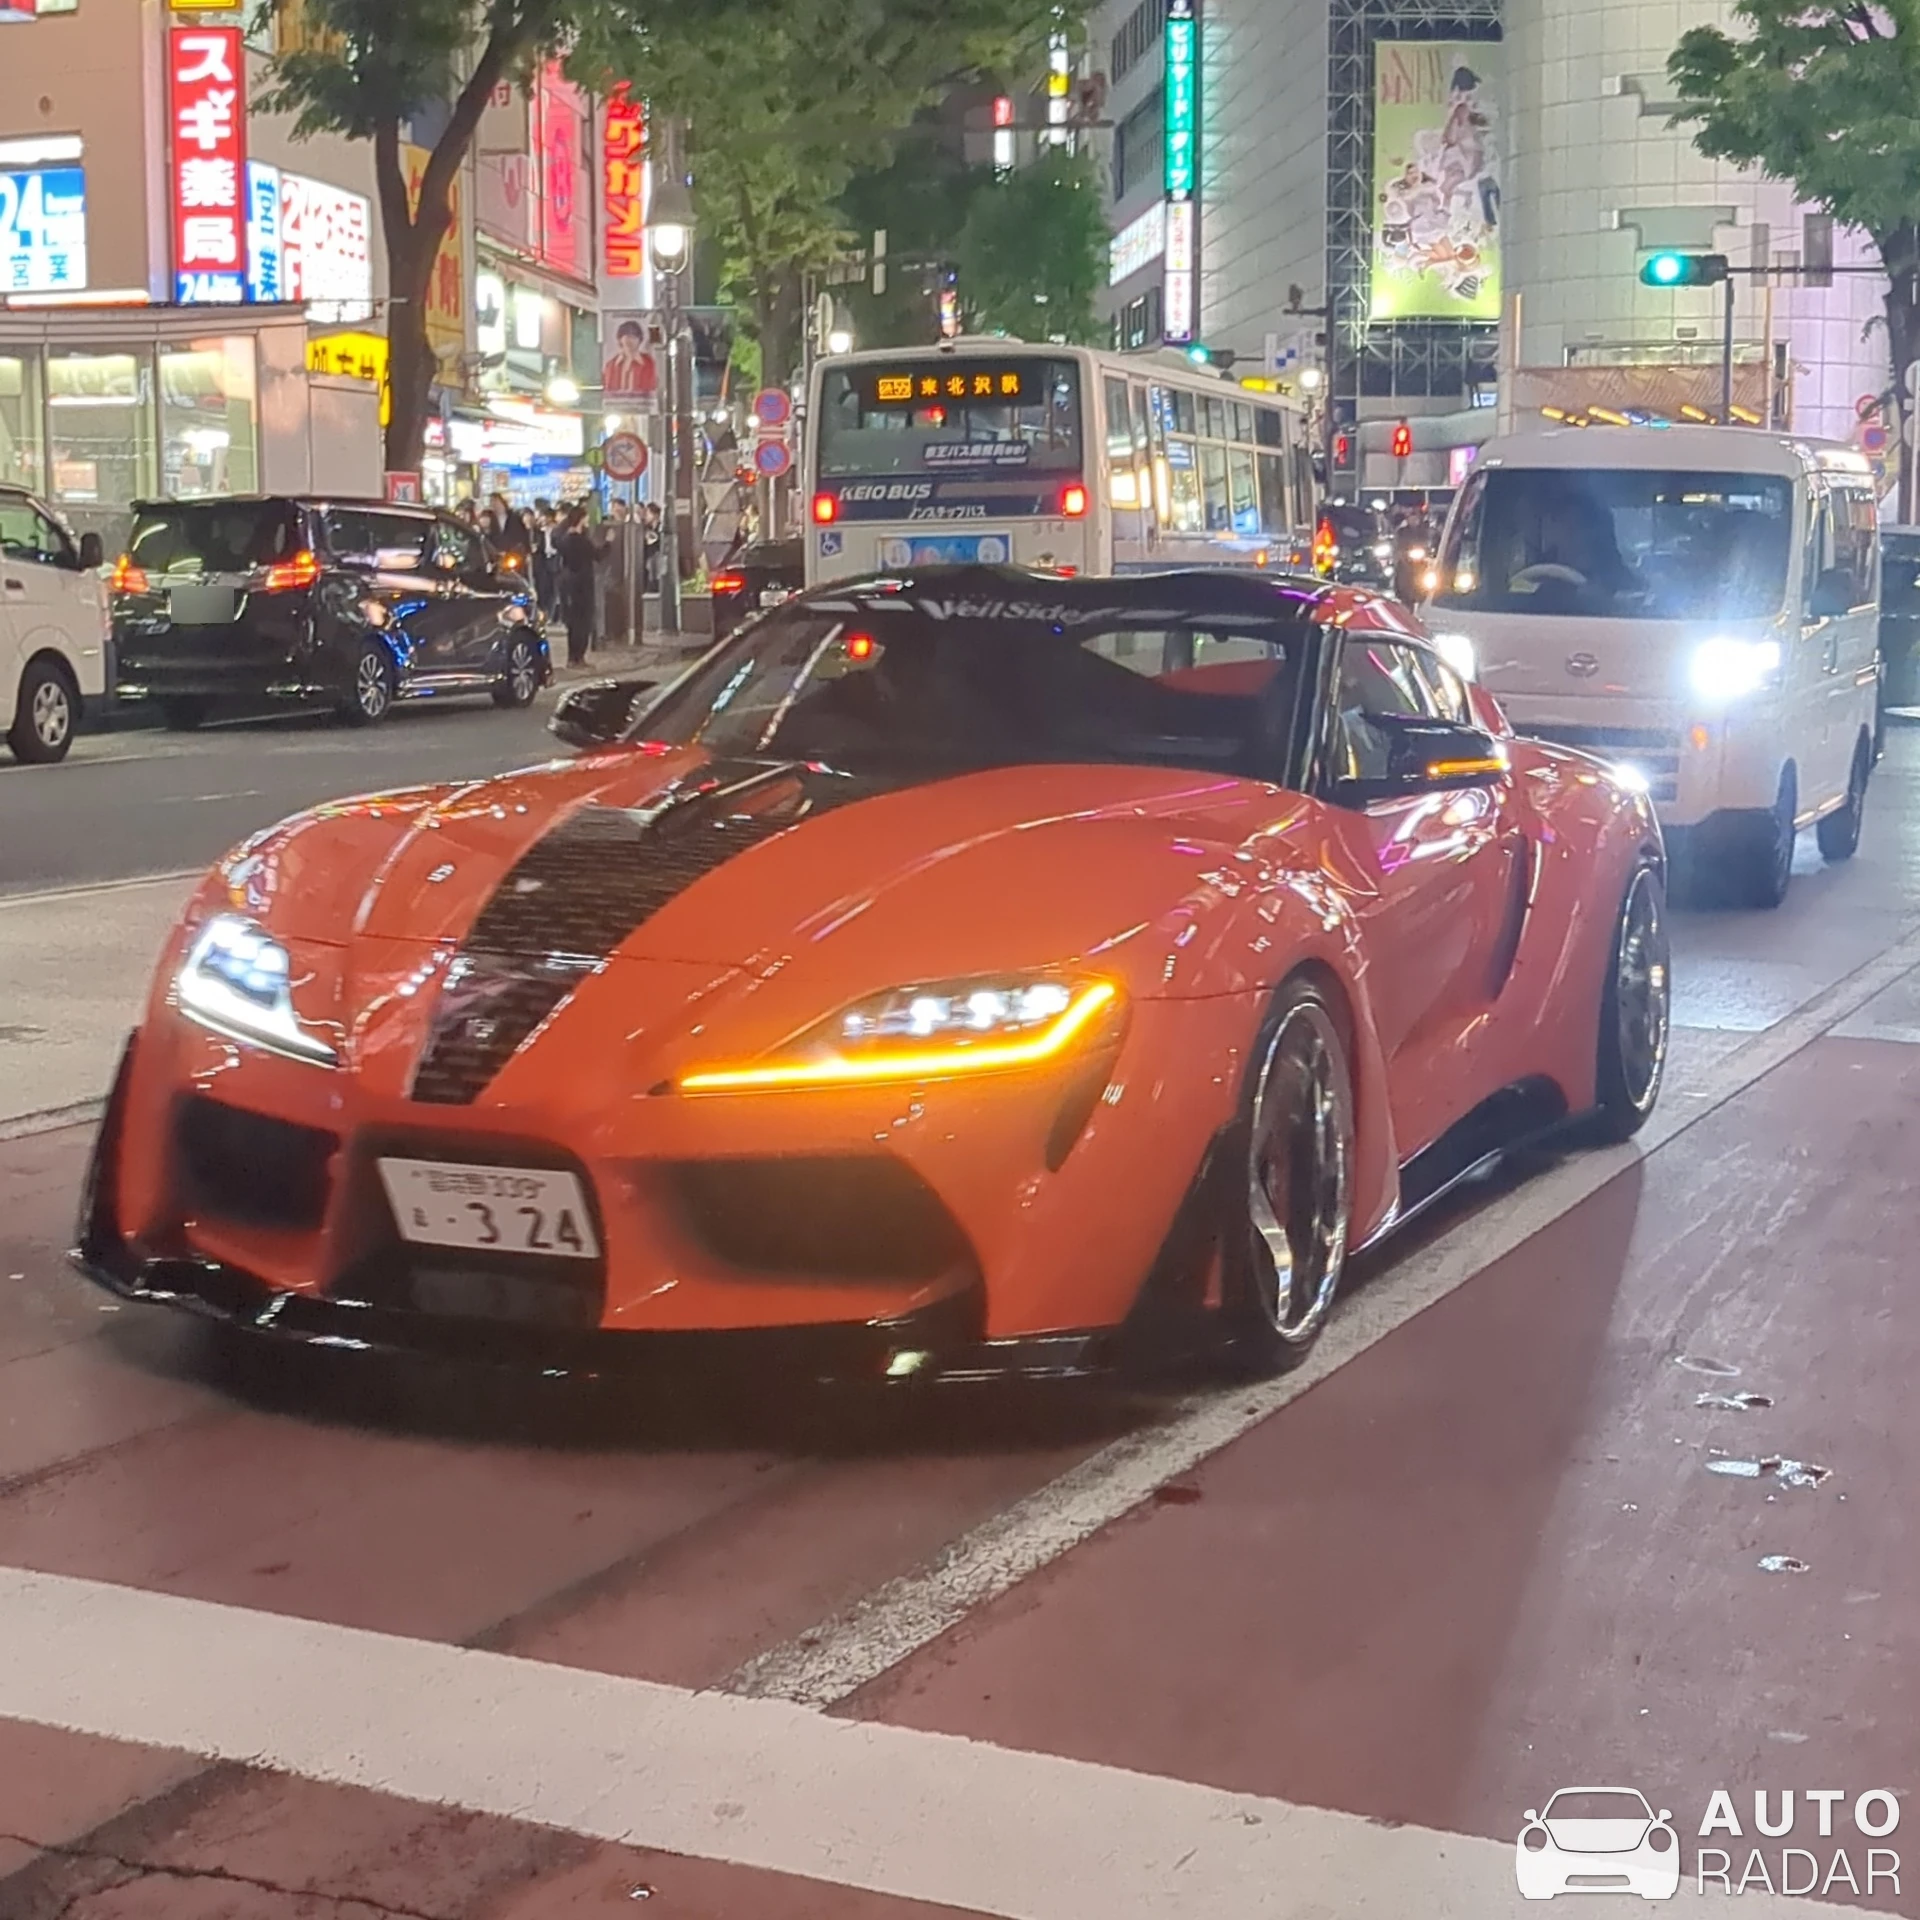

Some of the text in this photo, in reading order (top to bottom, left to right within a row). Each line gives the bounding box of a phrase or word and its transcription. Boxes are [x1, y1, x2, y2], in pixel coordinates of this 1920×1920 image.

[177, 36, 237, 264] スギ薬局
[9, 252, 69, 287] 営業
[180, 273, 243, 304] 24
[921, 374, 1019, 396] 東北沢駅
[839, 483, 932, 500] KEIO BUS
